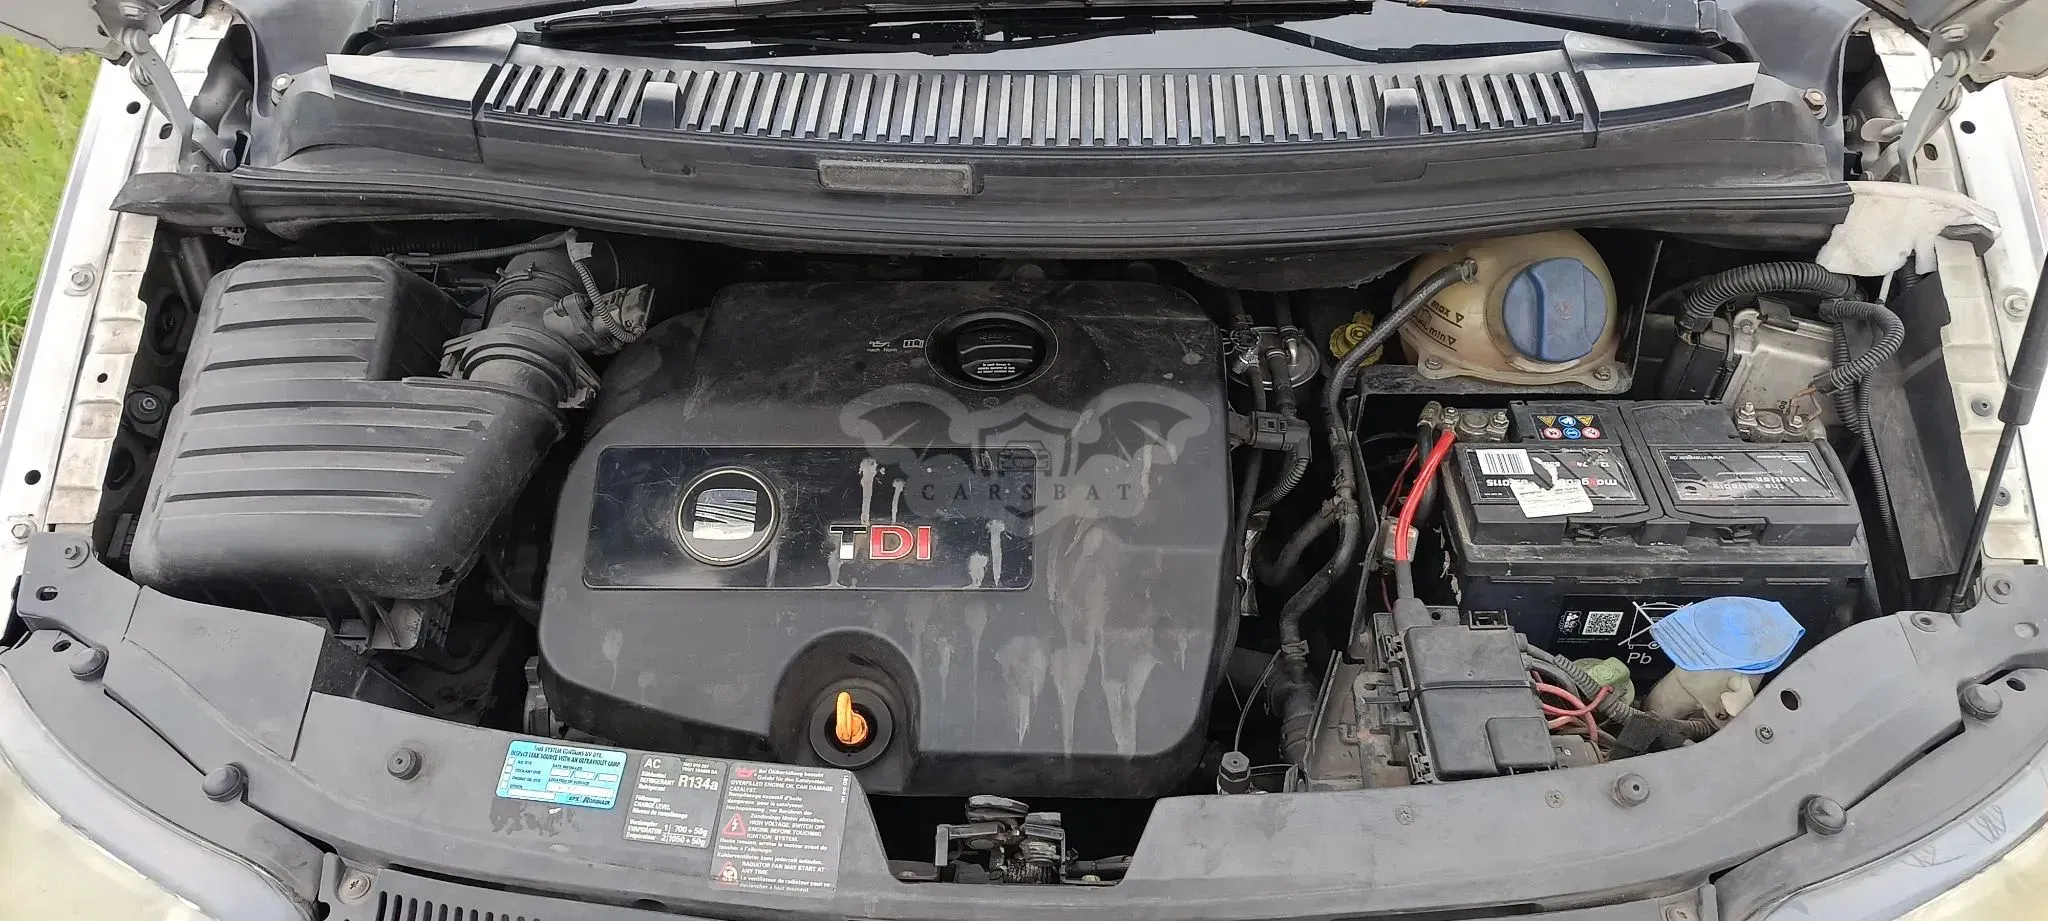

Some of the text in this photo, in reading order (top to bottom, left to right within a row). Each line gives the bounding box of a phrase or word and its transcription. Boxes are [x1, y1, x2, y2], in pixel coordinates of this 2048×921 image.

[1431, 301, 1450, 317] max
[1430, 328, 1446, 341] min
[829, 524, 932, 560] TDI
[1627, 652, 1652, 664] Pb
[644, 758, 661, 768] AC
[678, 774, 718, 791] R134a
[764, 781, 784, 789] ENGINE
[809, 784, 834, 792] DAMAGE
[694, 826, 708, 836] 50g
[692, 837, 706, 846] 50g
